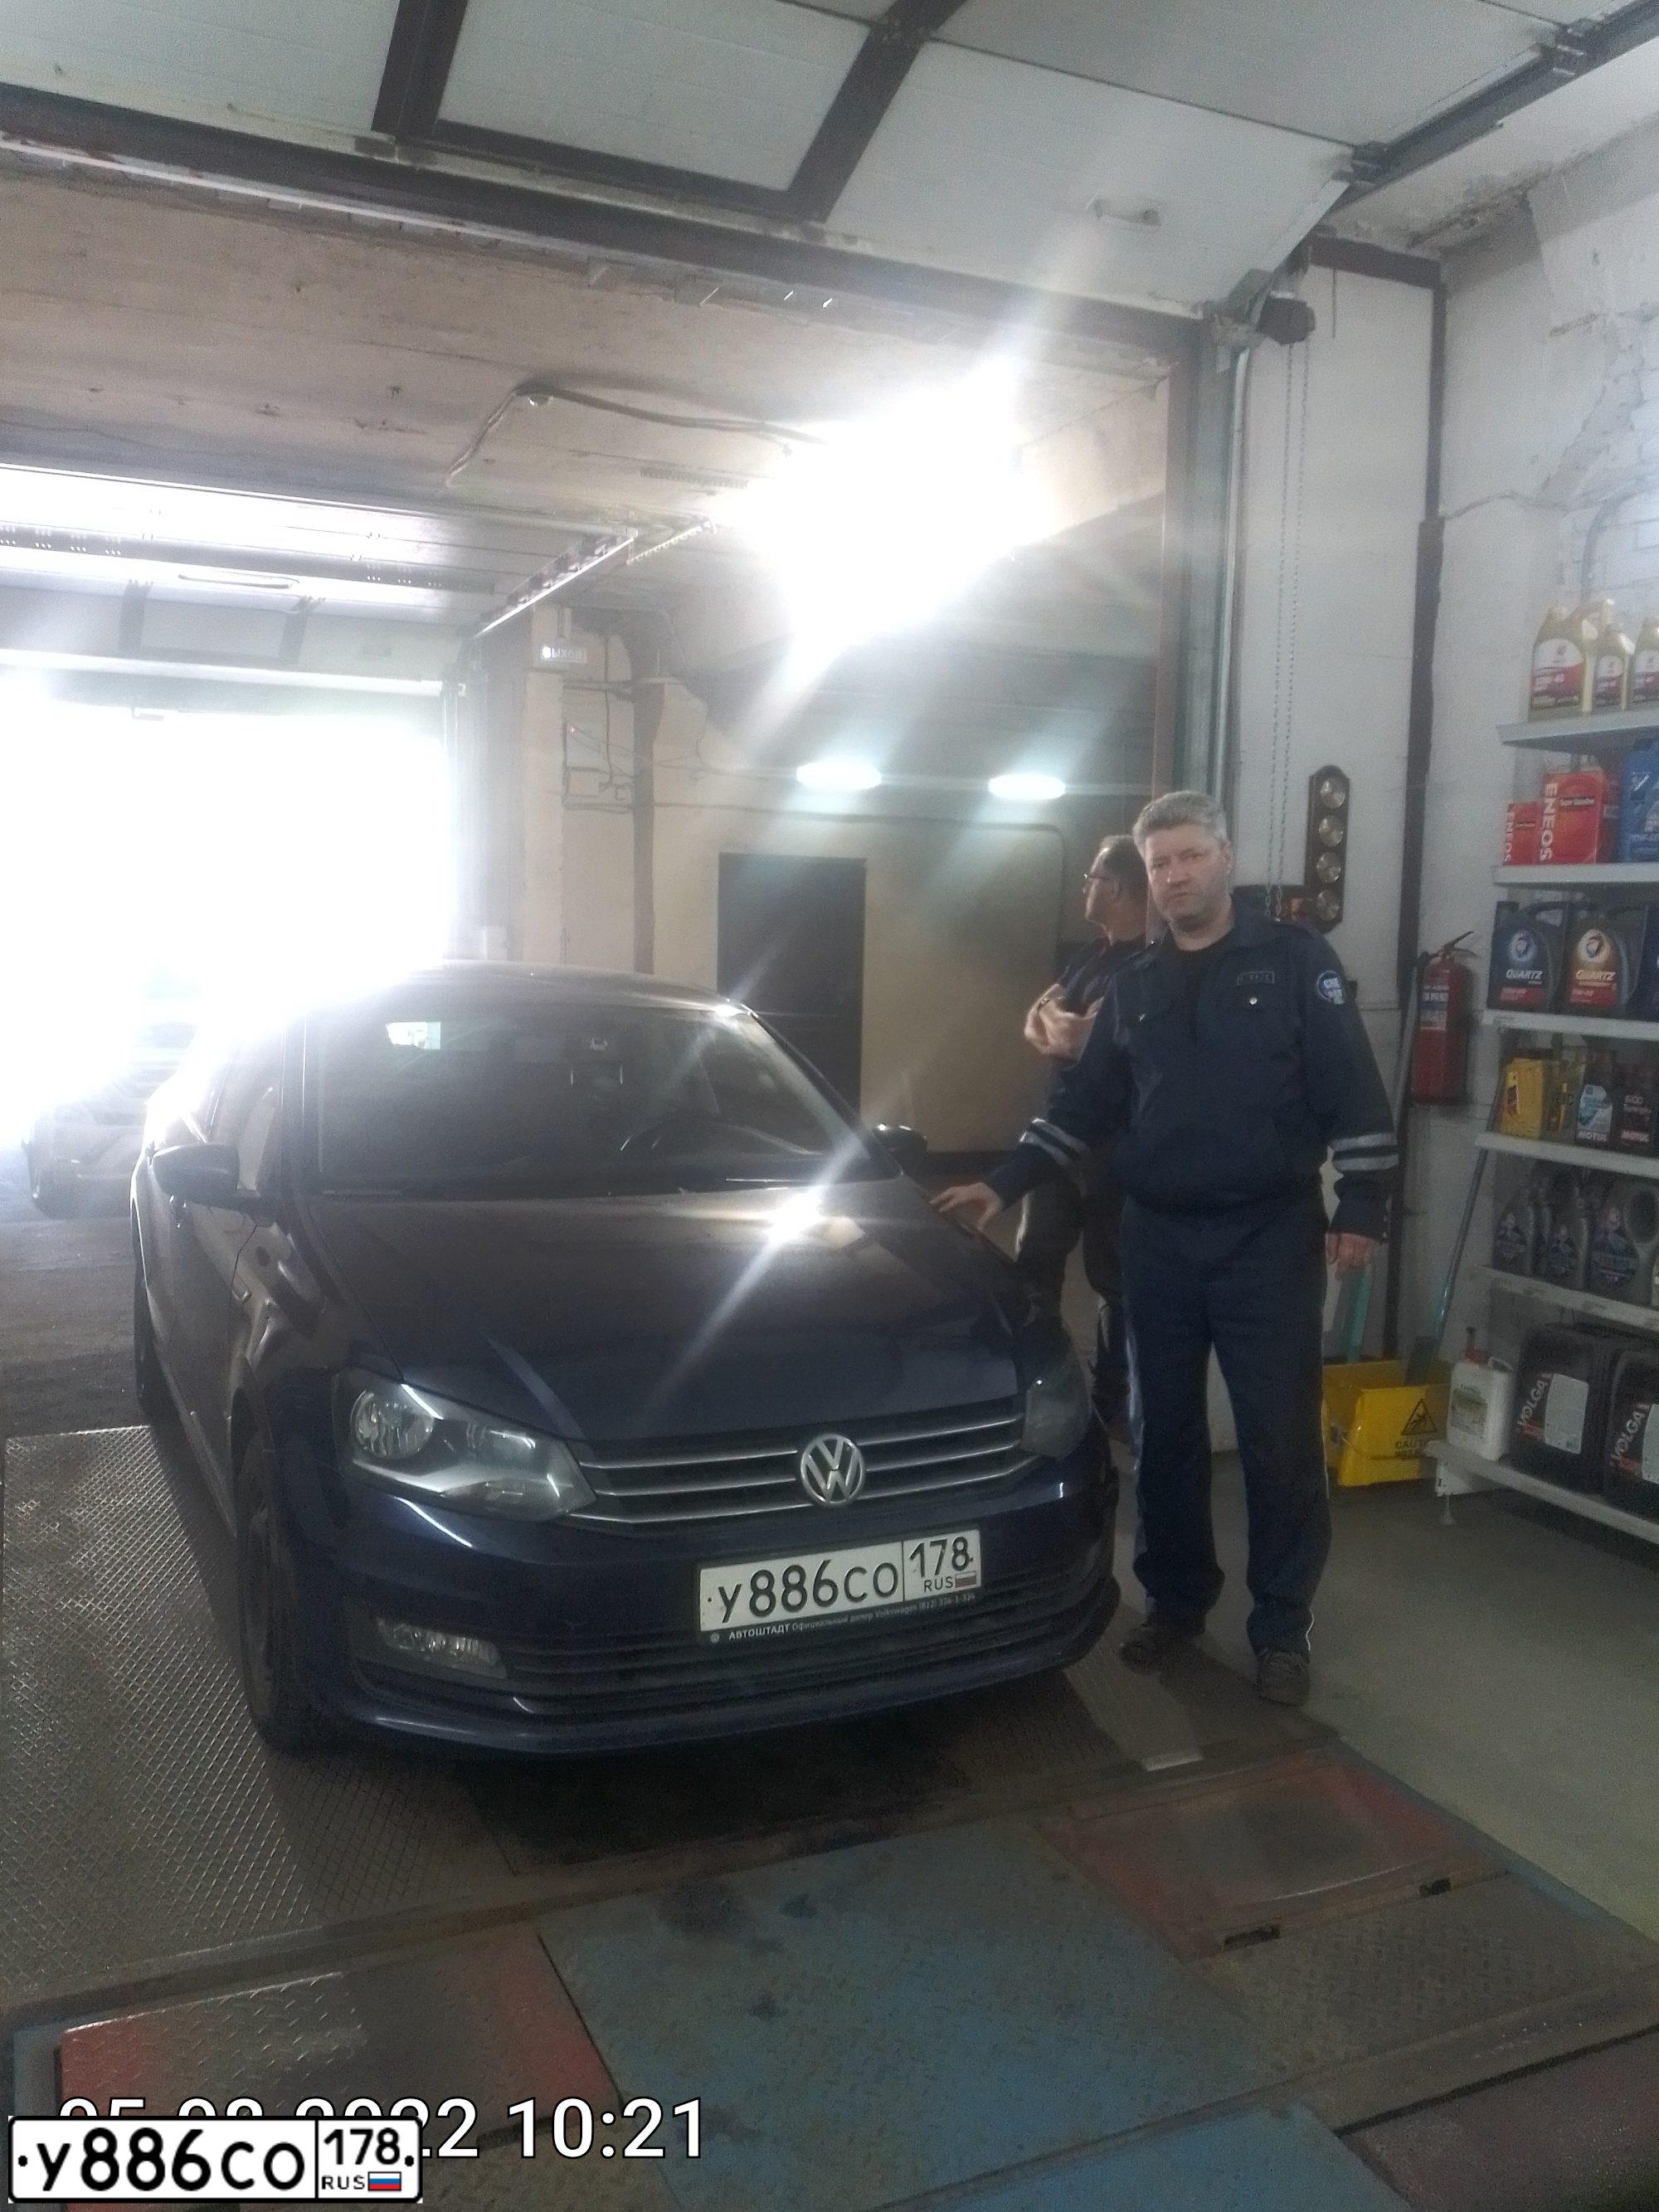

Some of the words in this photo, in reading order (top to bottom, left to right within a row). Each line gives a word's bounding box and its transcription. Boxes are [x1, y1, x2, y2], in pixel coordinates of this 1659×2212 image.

[1505, 811, 1515, 862] ENEOS
[1540, 782, 1558, 861] ENEOS
[1506, 968, 1544, 981] QUARTZ
[1575, 969, 1617, 982] QUARTZ
[909, 1536, 970, 1577] 178
[923, 1576, 954, 1593] RUS
[728, 1623, 791, 1641] АВТОШТАДТ
[875, 1604, 917, 1619] Volkswagen
